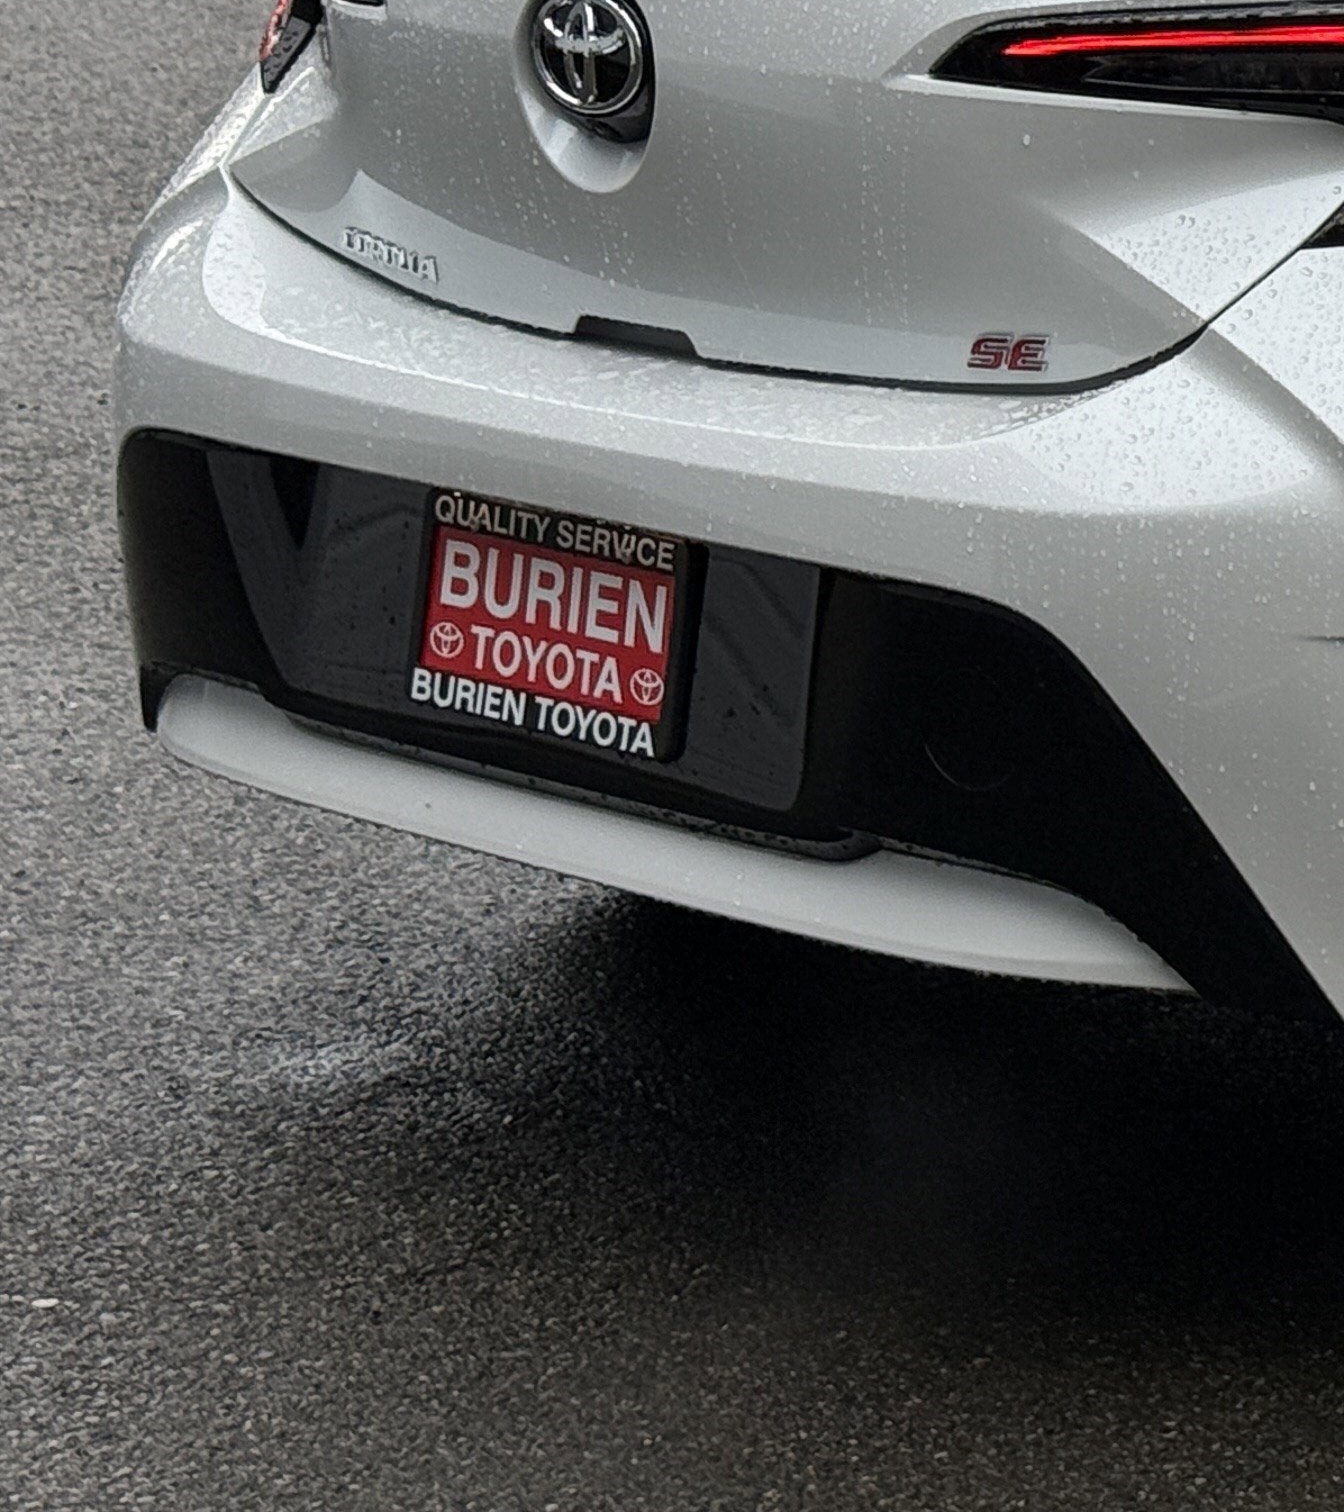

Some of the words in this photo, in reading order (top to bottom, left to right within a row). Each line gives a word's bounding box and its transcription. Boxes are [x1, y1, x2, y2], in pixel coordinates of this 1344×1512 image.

[966, 332, 1050, 372] SE
[435, 494, 550, 543] QUALITY
[556, 519, 676, 572] SERVICE
[440, 539, 668, 655] BURIEN
[471, 624, 623, 704] TOYOTA
[411, 667, 527, 727] BURIEN
[535, 696, 655, 758] TOYOTA
